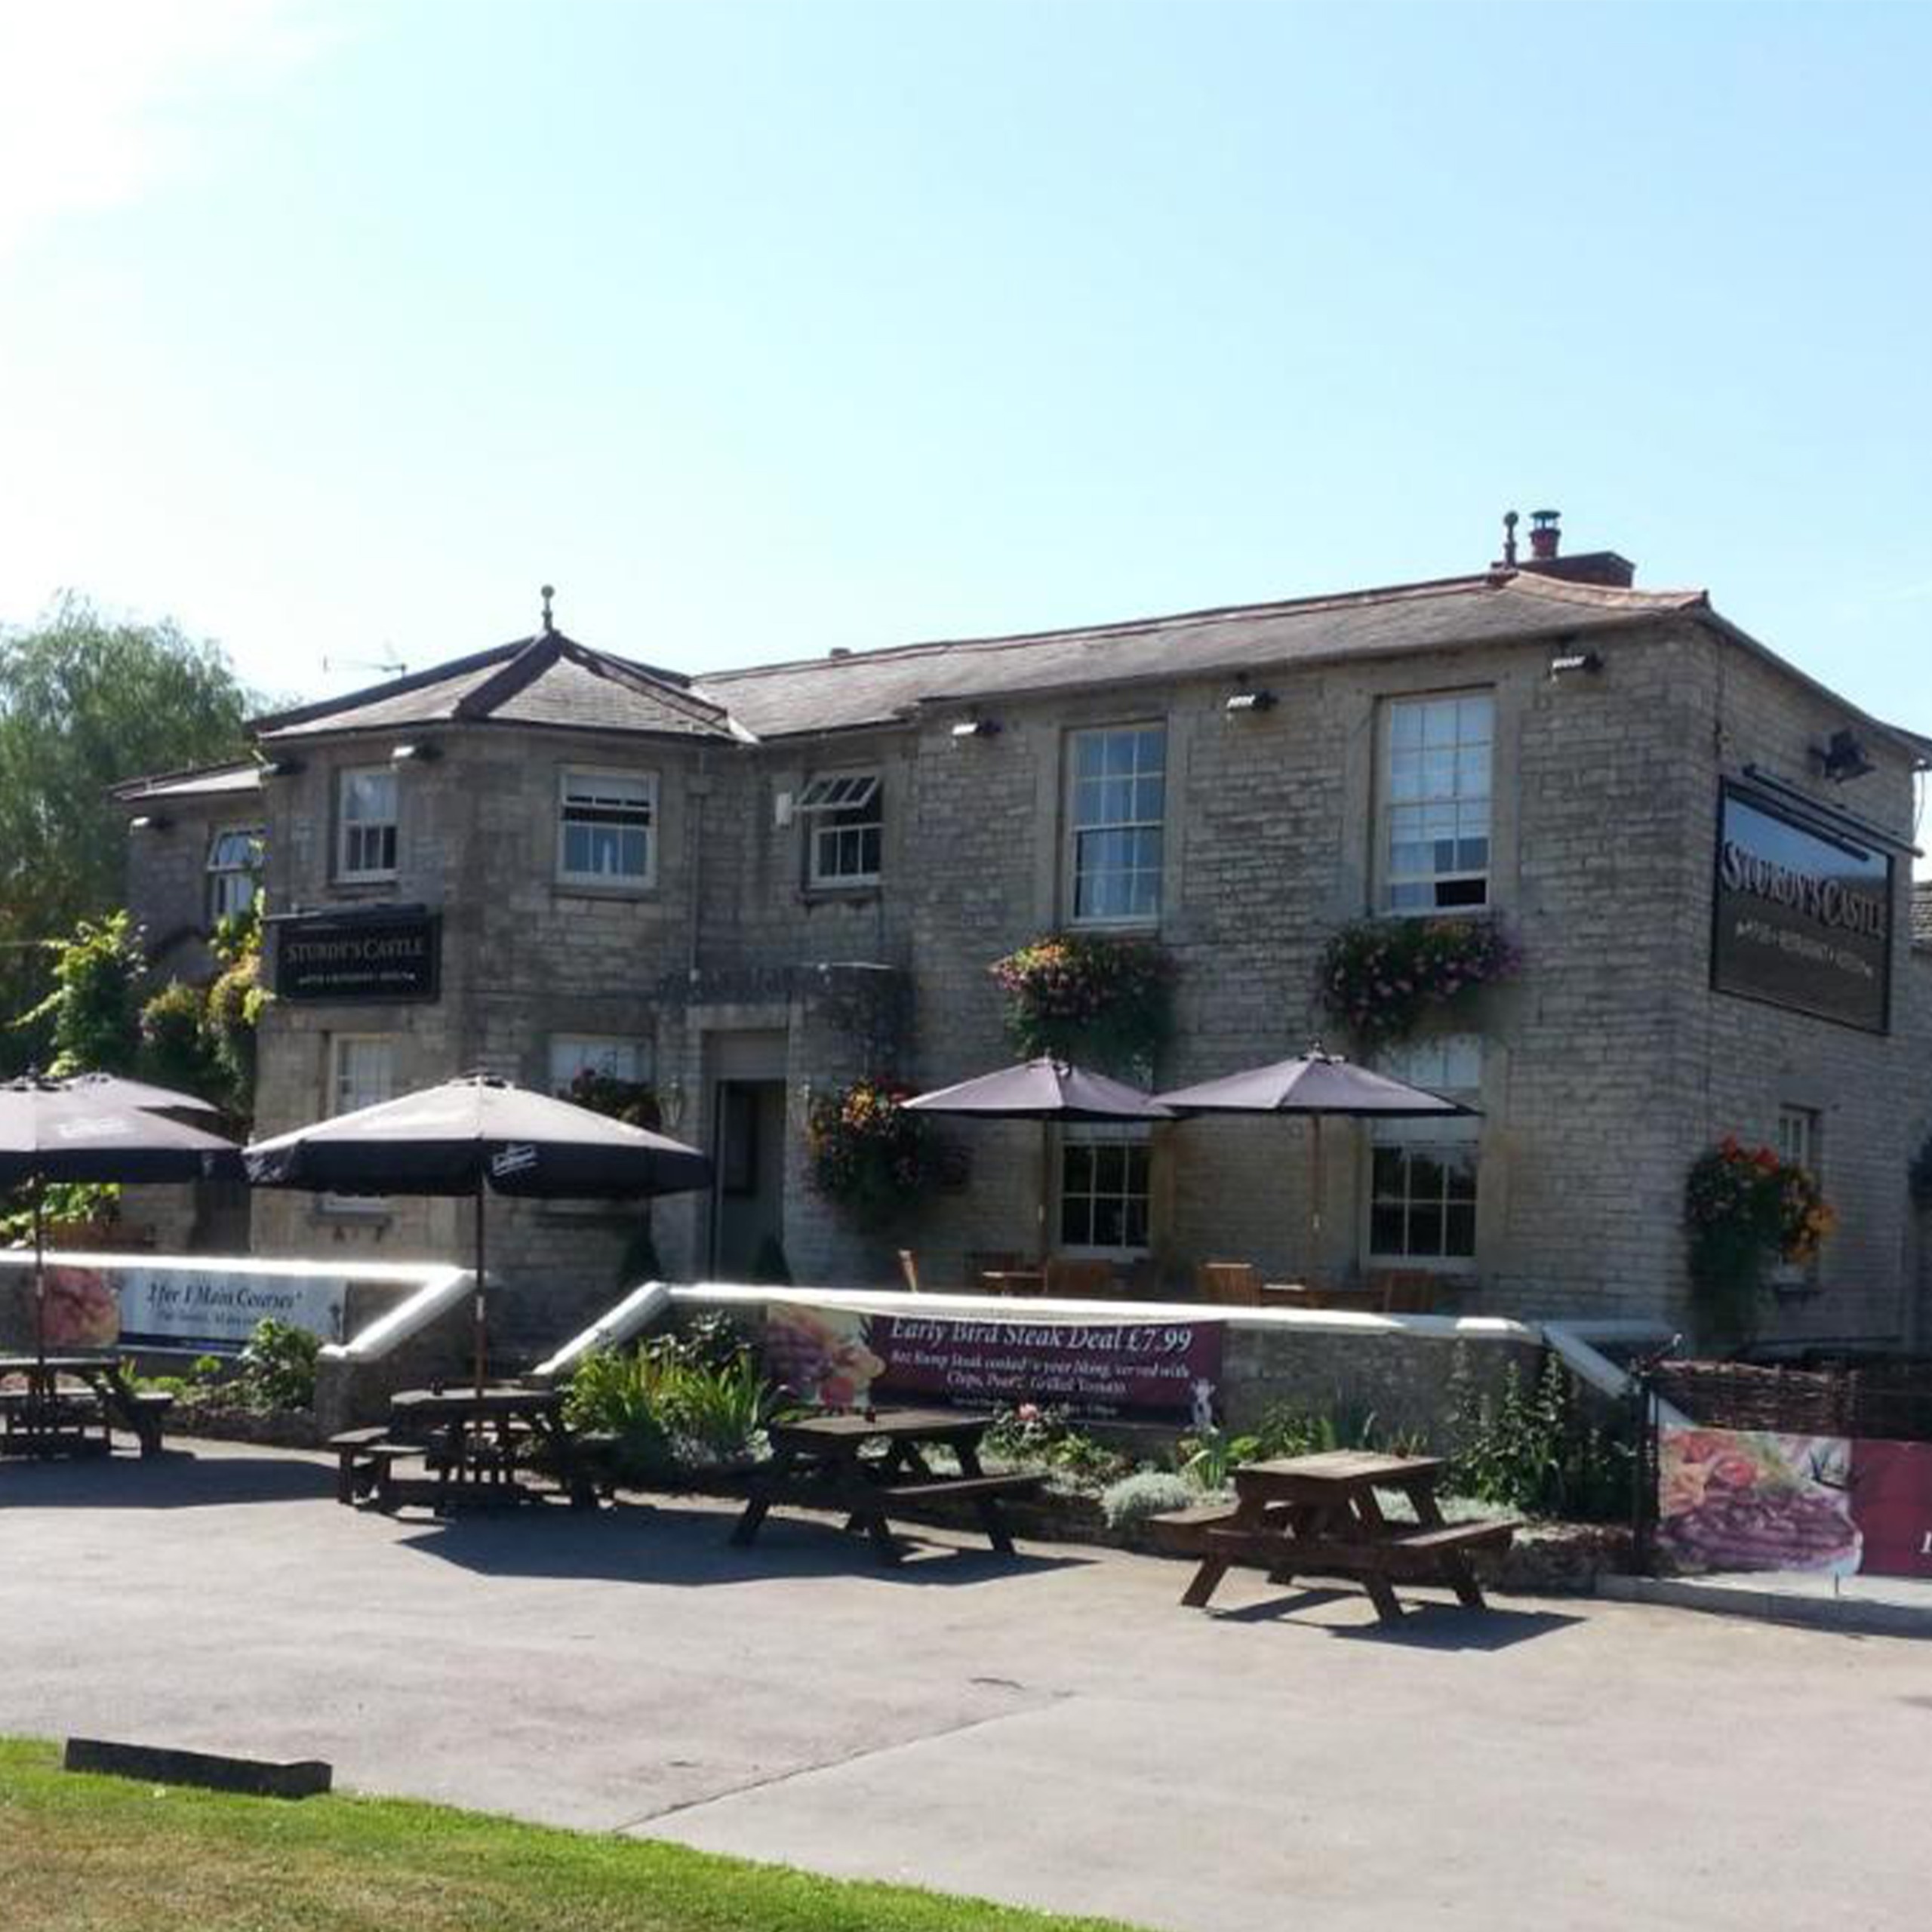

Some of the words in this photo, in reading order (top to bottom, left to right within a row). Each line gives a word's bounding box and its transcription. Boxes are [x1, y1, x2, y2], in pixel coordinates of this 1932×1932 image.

[891, 1318, 945, 1349] Early
[952, 1320, 998, 1343] Bird
[1004, 1325, 1062, 1346] Steak
[1067, 1327, 1122, 1350] Deal
[1128, 1327, 1192, 1352] £7.99
